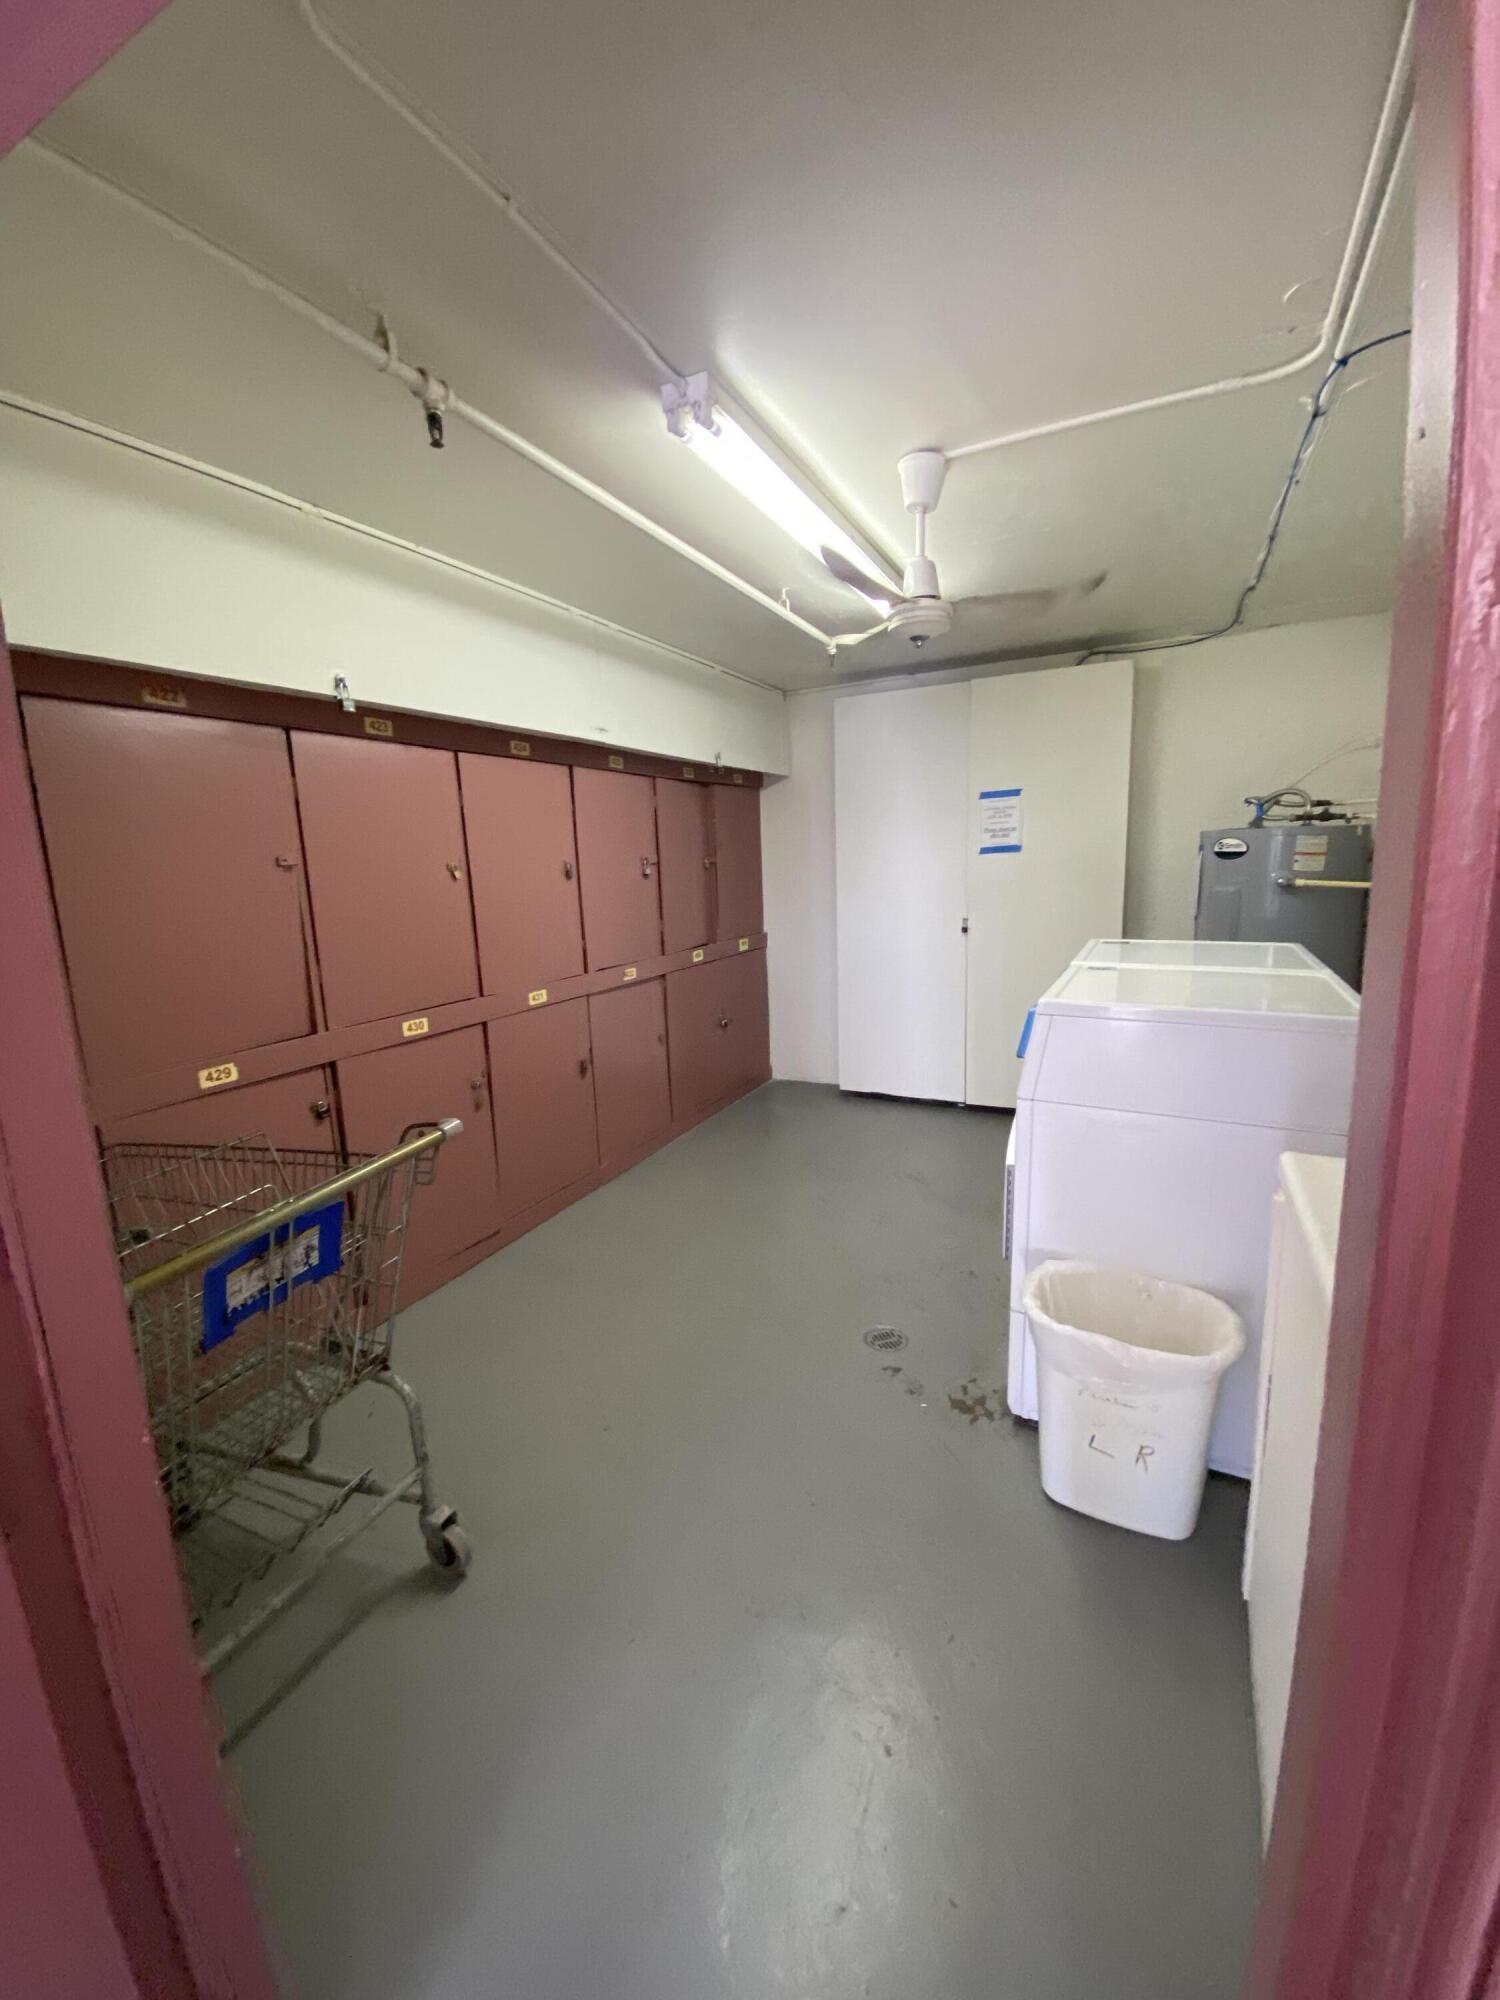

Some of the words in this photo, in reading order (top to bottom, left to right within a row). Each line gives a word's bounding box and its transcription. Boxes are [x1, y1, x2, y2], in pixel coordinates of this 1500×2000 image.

[368, 720, 389, 733] 423
[406, 1020, 425, 1033] 430
[205, 1066, 232, 1083] 429
[1088, 1434, 1115, 1459] L
[1135, 1444, 1156, 1473] R
